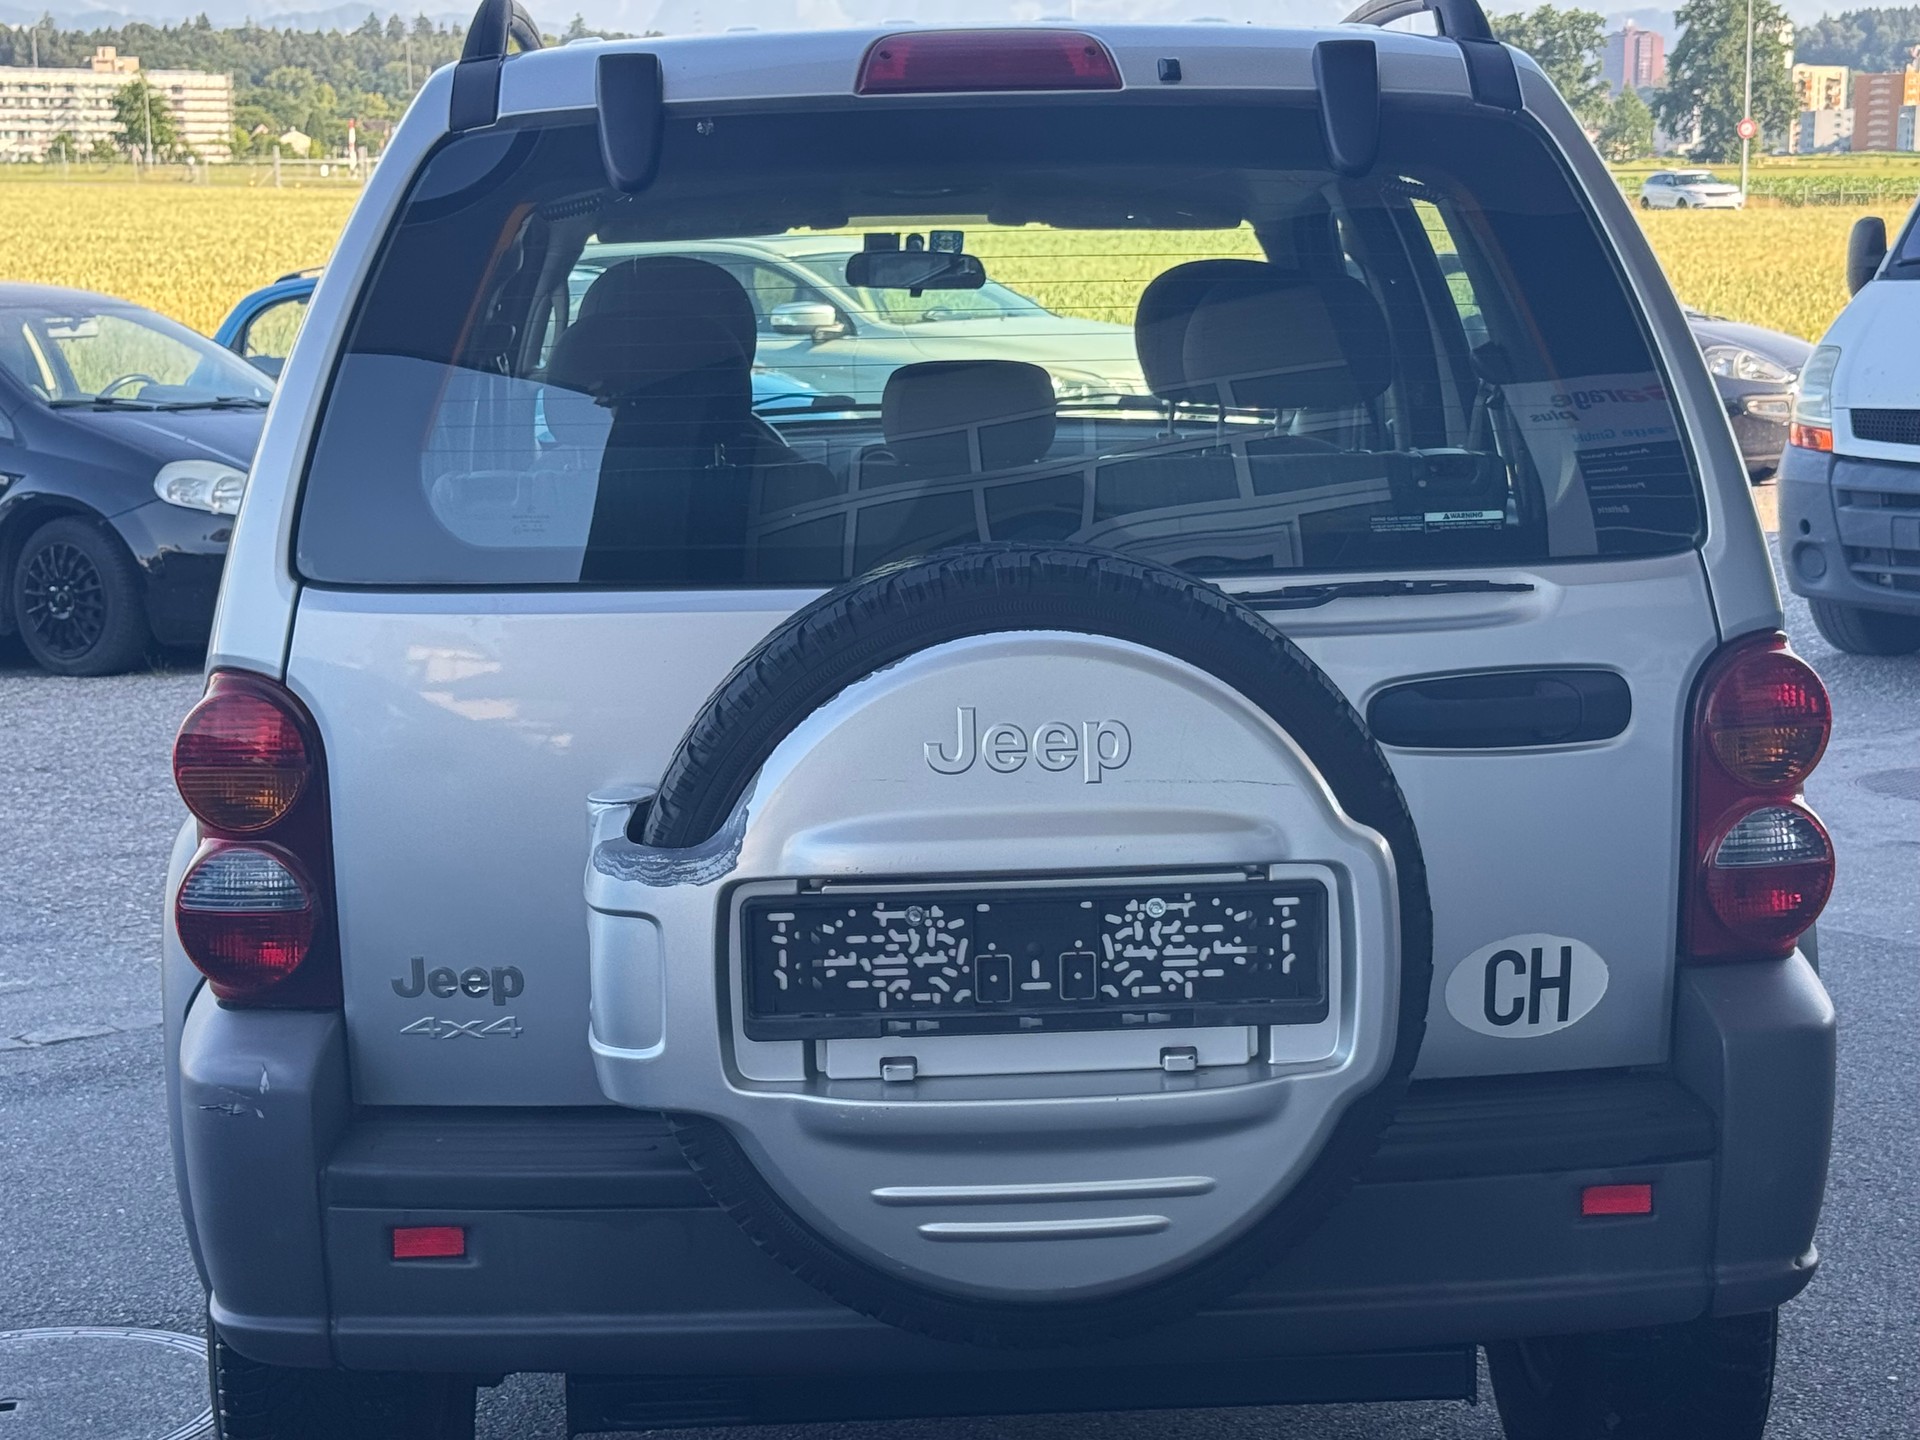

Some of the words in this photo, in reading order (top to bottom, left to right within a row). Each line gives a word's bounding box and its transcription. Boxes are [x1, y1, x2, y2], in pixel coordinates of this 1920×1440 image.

[1450, 511, 1484, 519] WARNING
[923, 706, 1132, 784] Jeep
[391, 956, 525, 1007] Jeep
[1484, 946, 1572, 1026] CH
